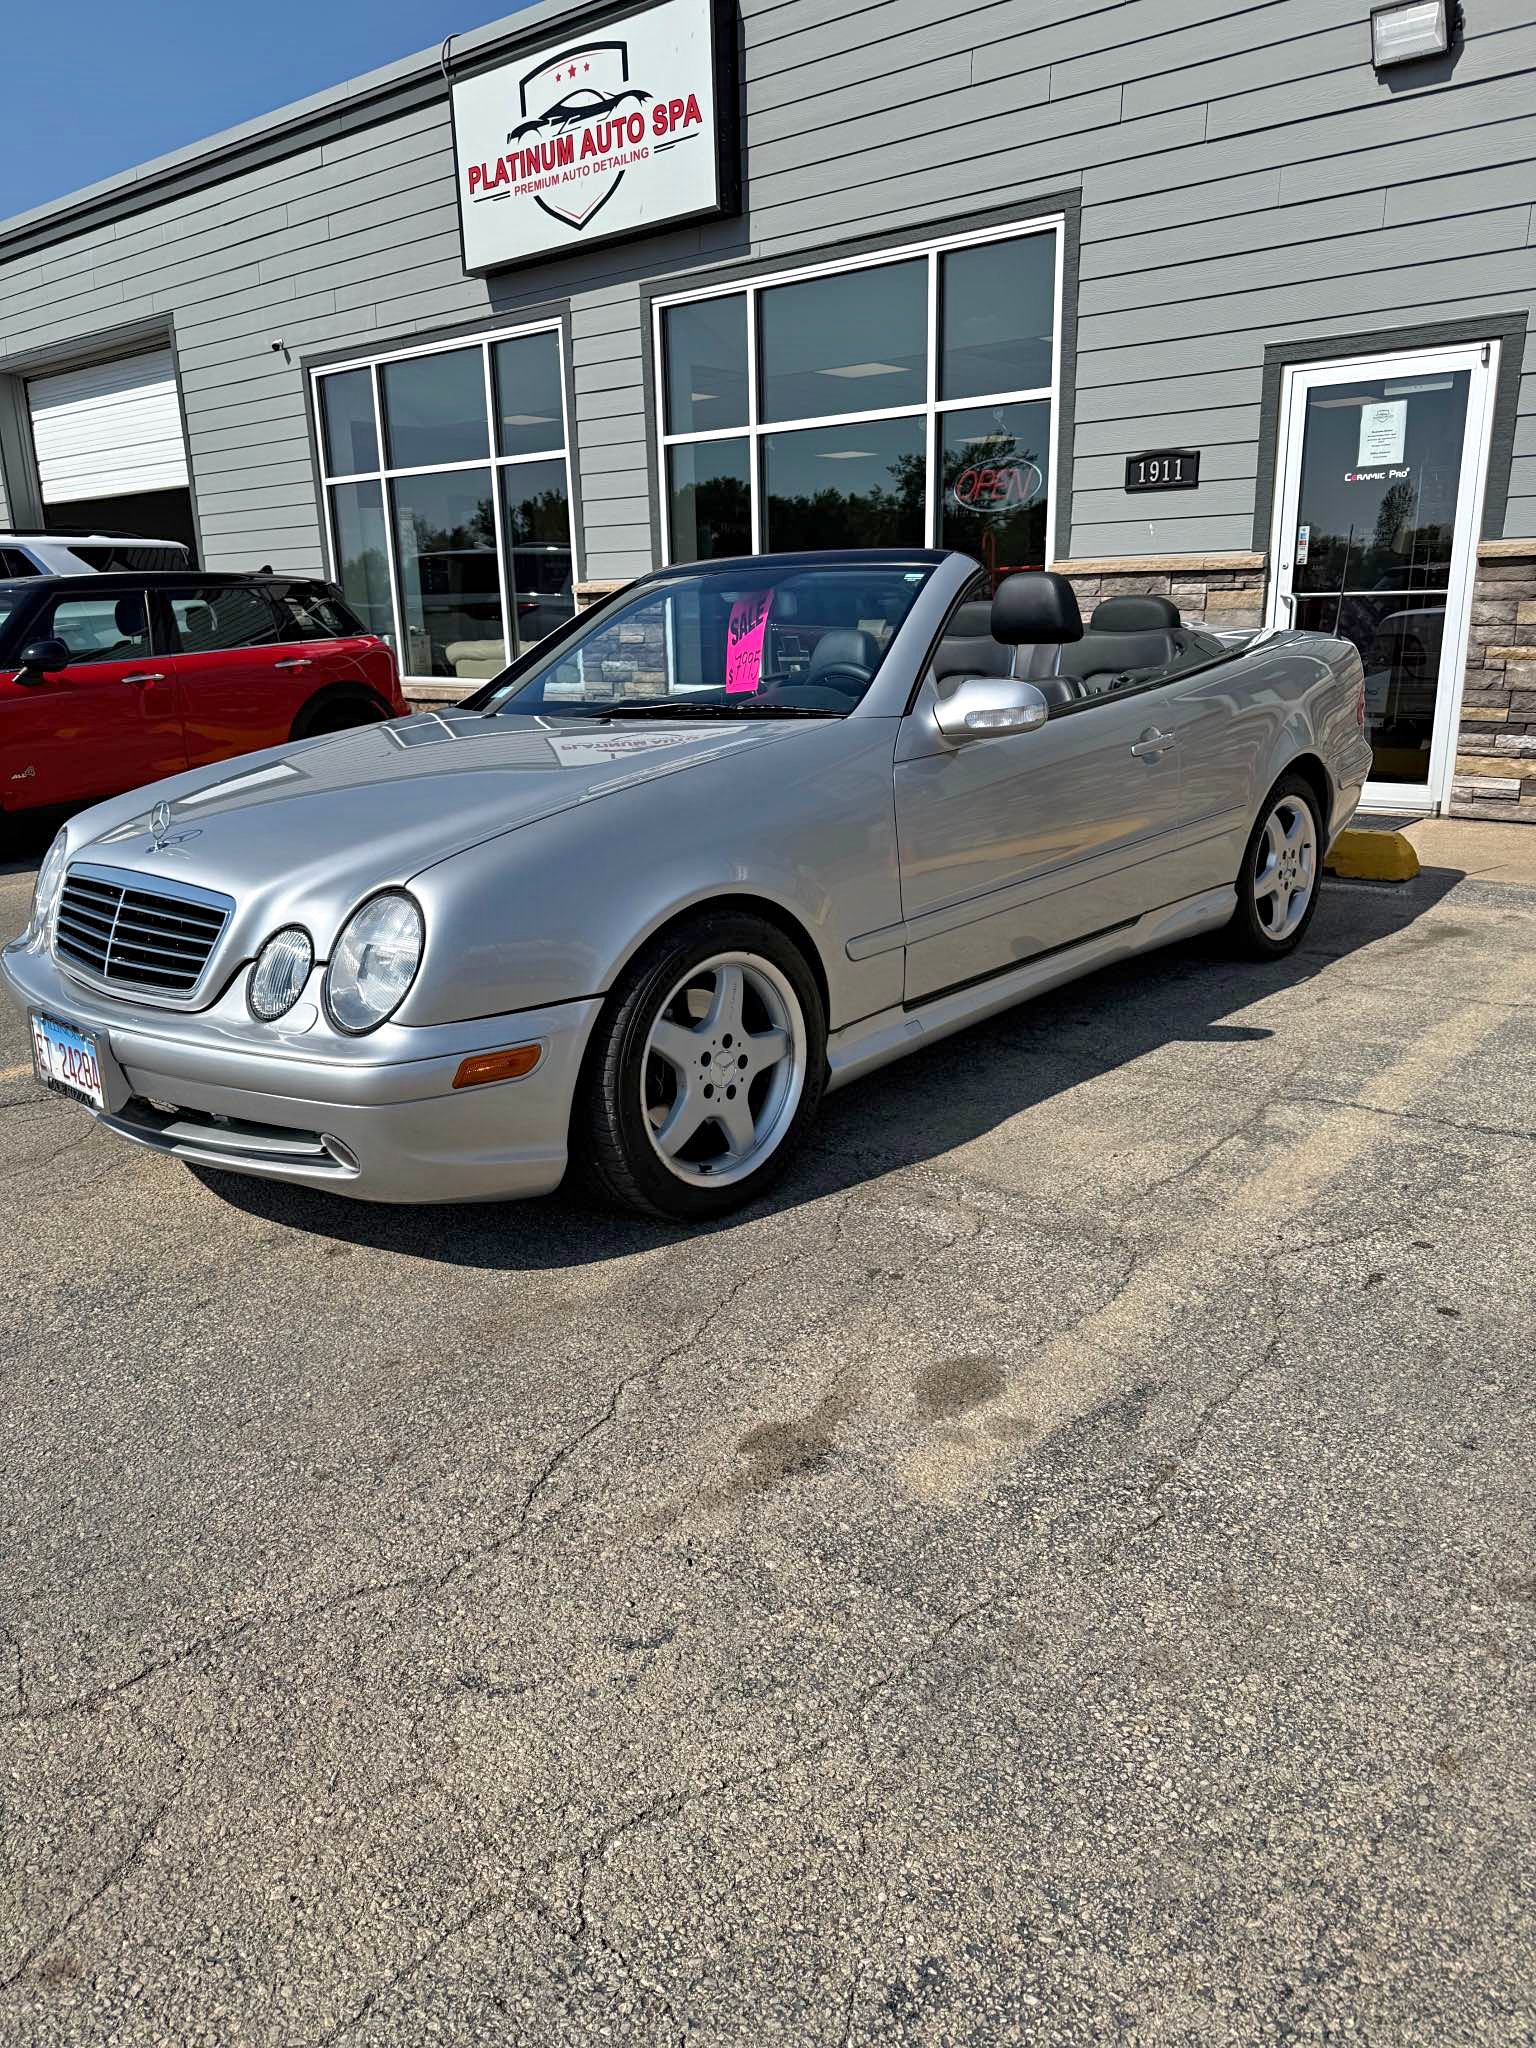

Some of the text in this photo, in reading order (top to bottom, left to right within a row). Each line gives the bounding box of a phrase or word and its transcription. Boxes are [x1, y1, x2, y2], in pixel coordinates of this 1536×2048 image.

[468, 94, 703, 194] PLATINUM AUTO SPA
[514, 147, 650, 197] PREMIUM AUTO DETAILING
[956, 468, 1035, 501] OPEN
[1138, 459, 1183, 483] 1911
[730, 598, 768, 646] SALE
[59, 1042, 101, 1094] 24284
